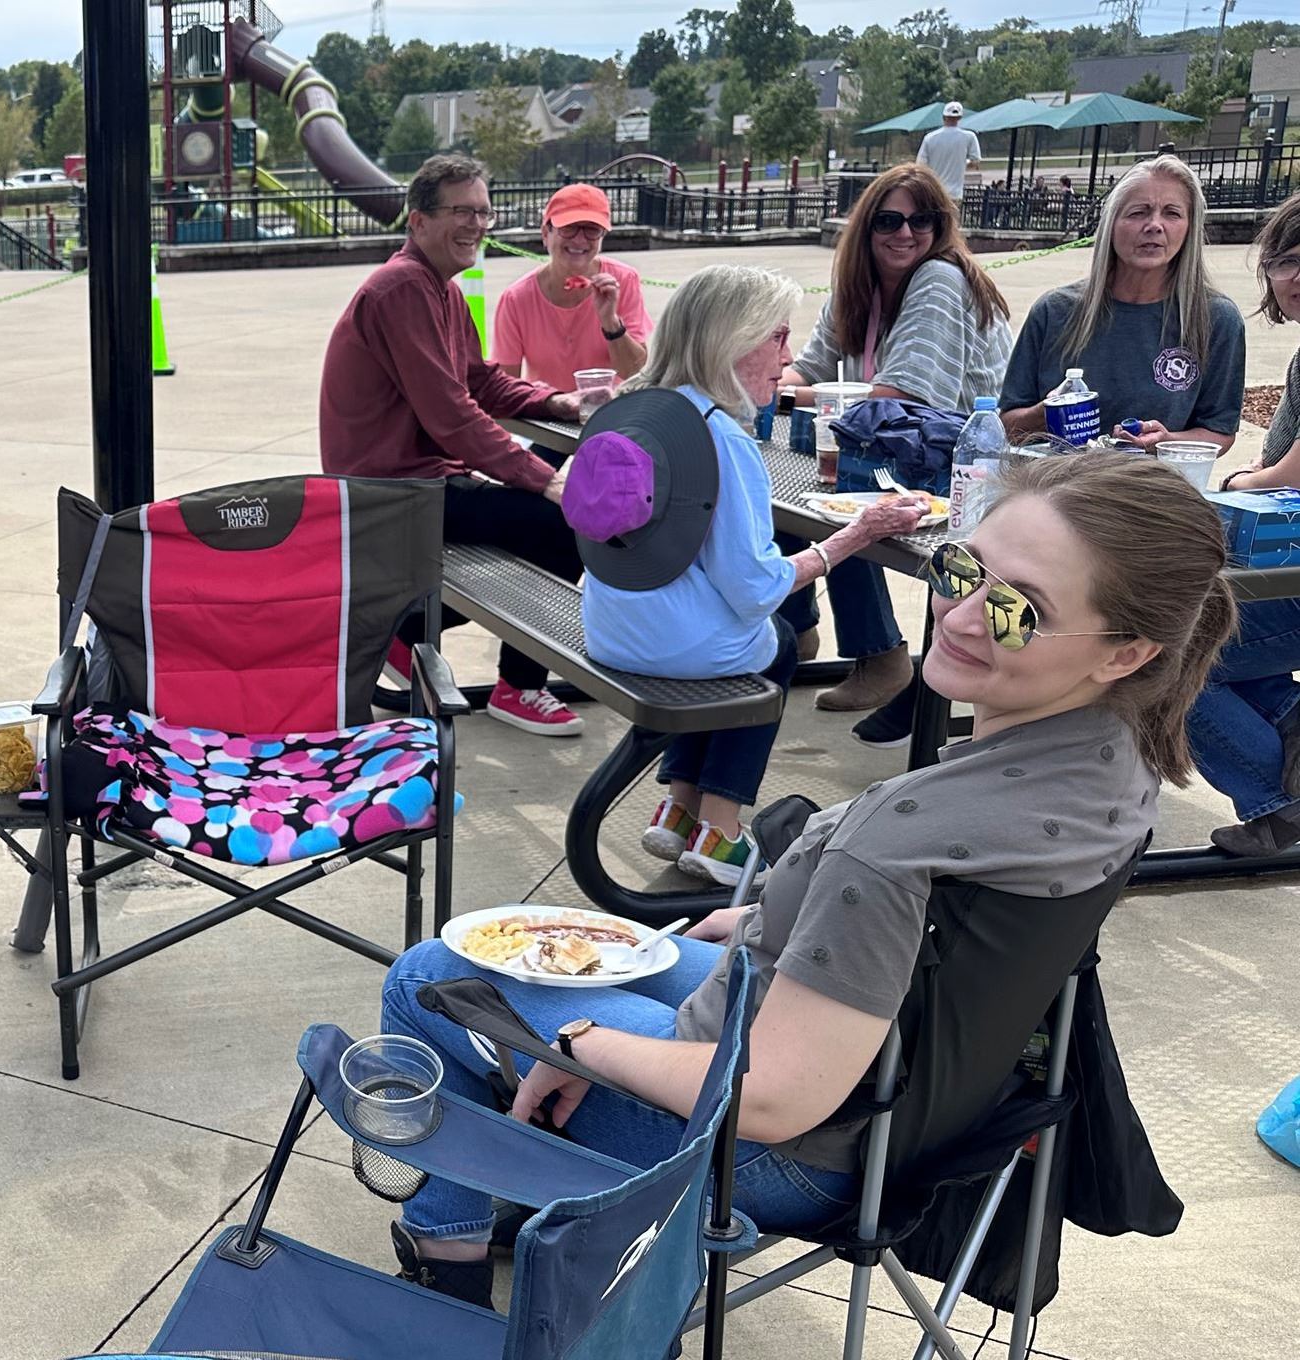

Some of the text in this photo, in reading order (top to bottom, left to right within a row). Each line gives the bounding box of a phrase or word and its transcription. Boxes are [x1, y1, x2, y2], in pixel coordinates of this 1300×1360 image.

[1068, 409, 1095, 421] SPRING
[951, 480, 964, 529] evian
[218, 506, 263, 520] TIMBER
[228, 516, 265, 529] RIDGE
